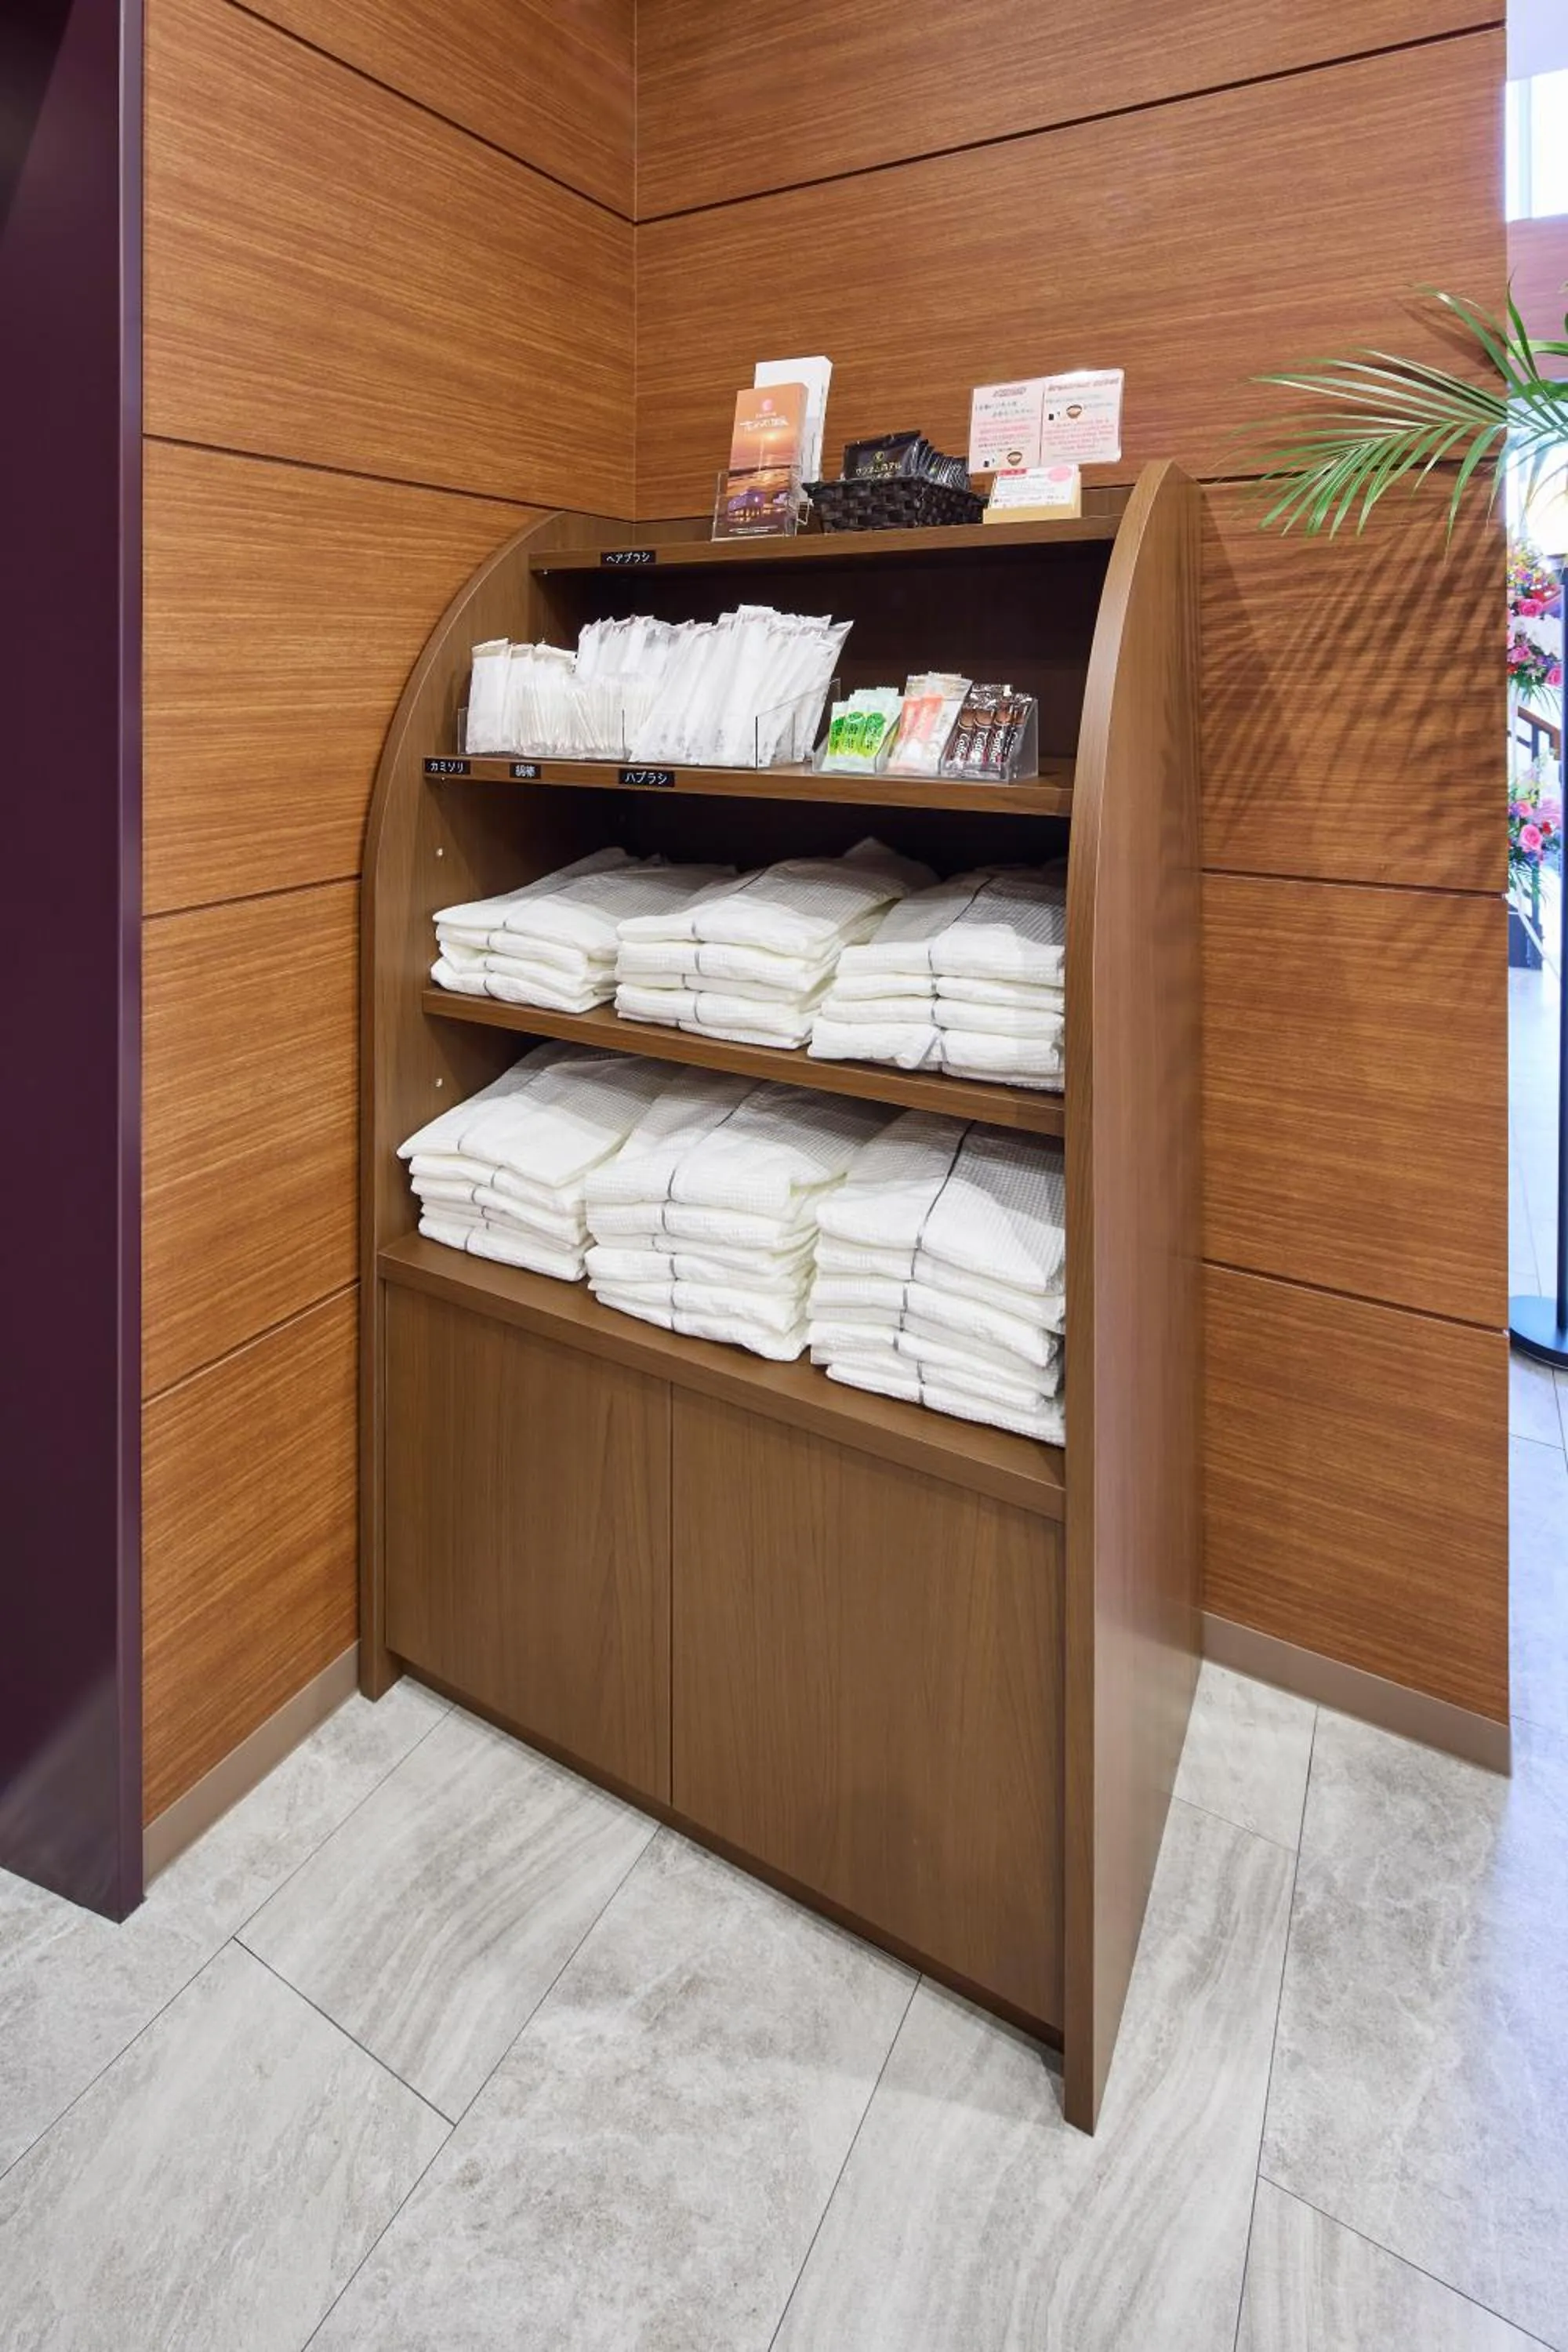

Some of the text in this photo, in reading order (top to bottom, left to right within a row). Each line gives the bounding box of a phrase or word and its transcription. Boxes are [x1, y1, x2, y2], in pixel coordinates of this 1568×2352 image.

[606, 551, 651, 564] ヘアブラシ
[430, 760, 463, 773] カミソリ
[625, 771, 667, 785] ハブラシ
